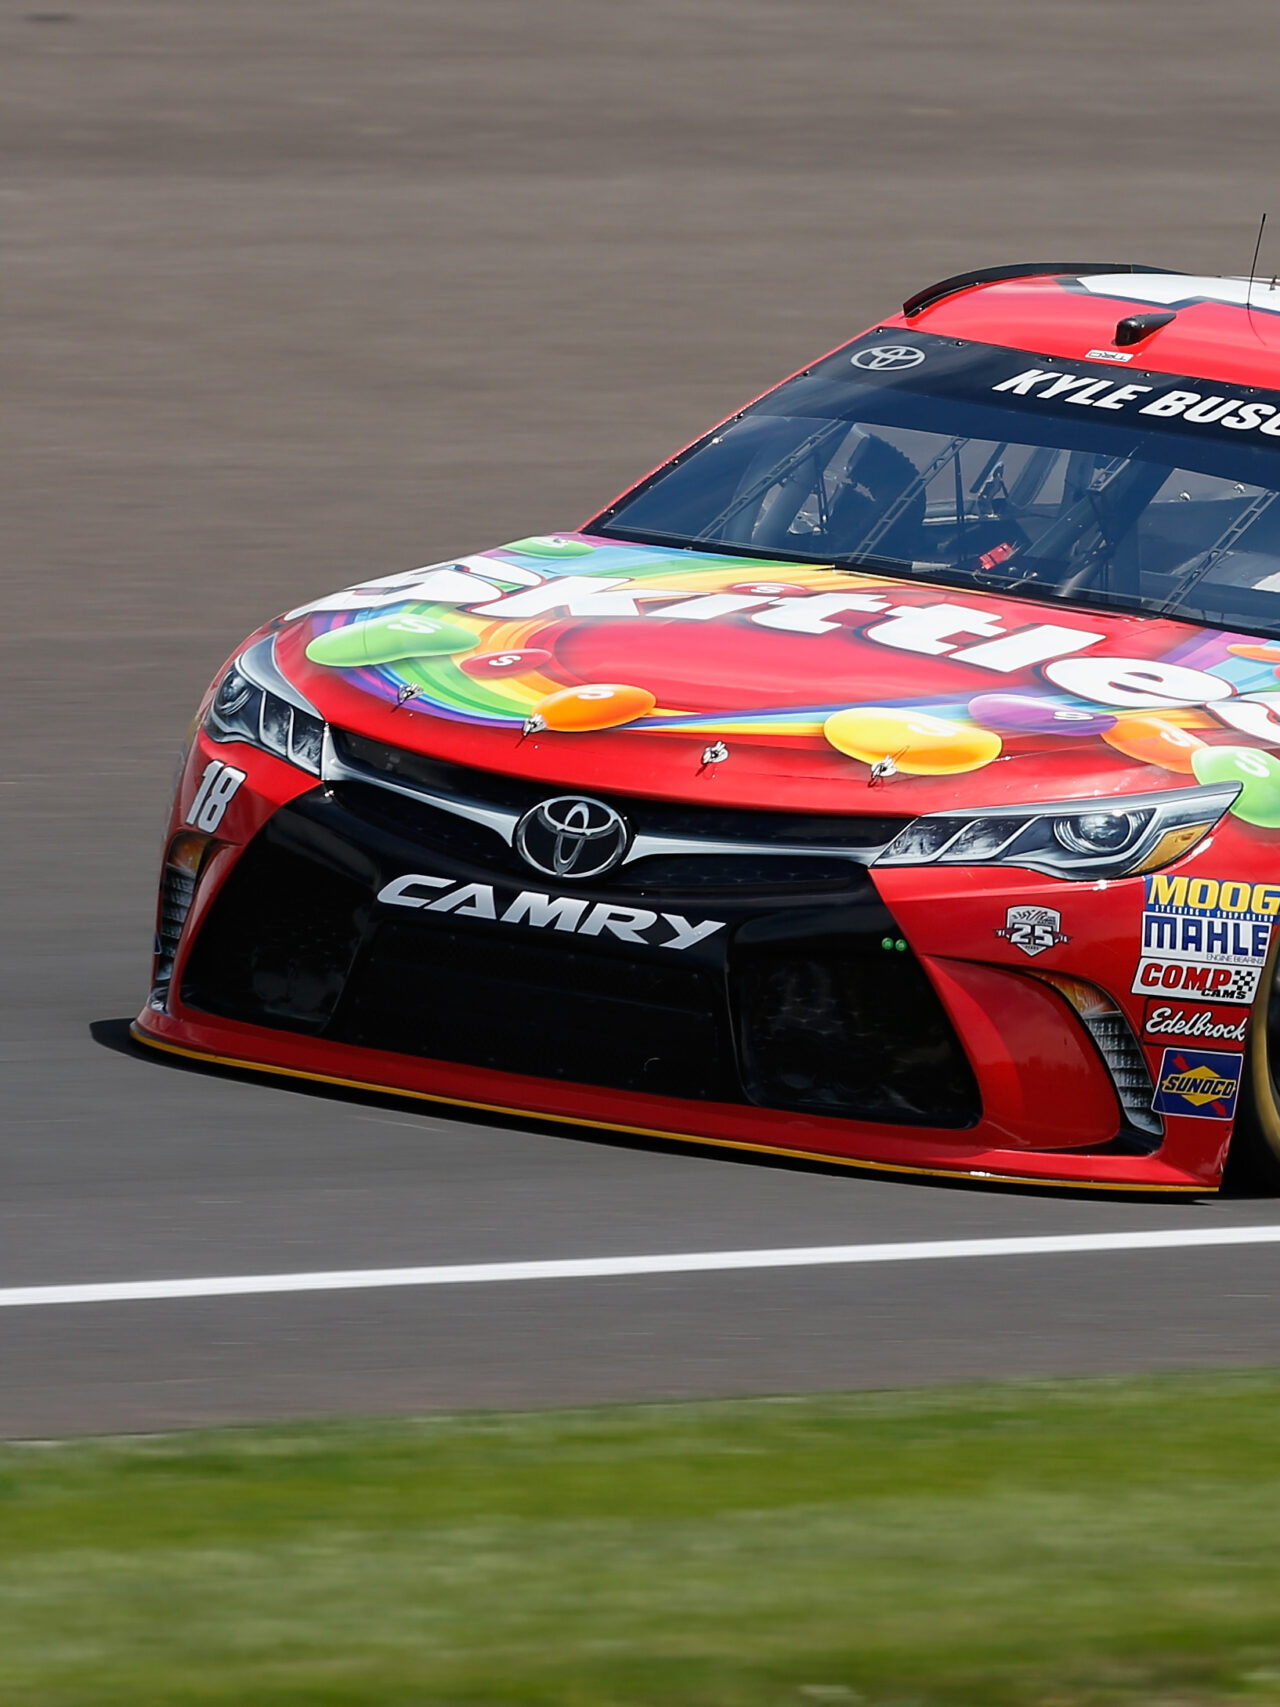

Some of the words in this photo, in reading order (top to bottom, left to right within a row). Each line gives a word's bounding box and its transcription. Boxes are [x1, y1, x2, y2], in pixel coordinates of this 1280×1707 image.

[993, 368, 1154, 409] KYLE
[185, 759, 248, 834] 18
[377, 873, 727, 950] CAMRY
[1155, 904, 1200, 916] STEERING
[1216, 910, 1274, 922] SUSPENSION
[1009, 922, 1055, 948] 25
[1144, 914, 1270, 957] MAHLE
[1206, 953, 1233, 962] ENGINE
[1140, 962, 1233, 992] COMP
[1200, 988, 1248, 1000] CAMS
[1145, 1006, 1249, 1042] Edelbrock
[1164, 1075, 1235, 1098] SUNOCO
